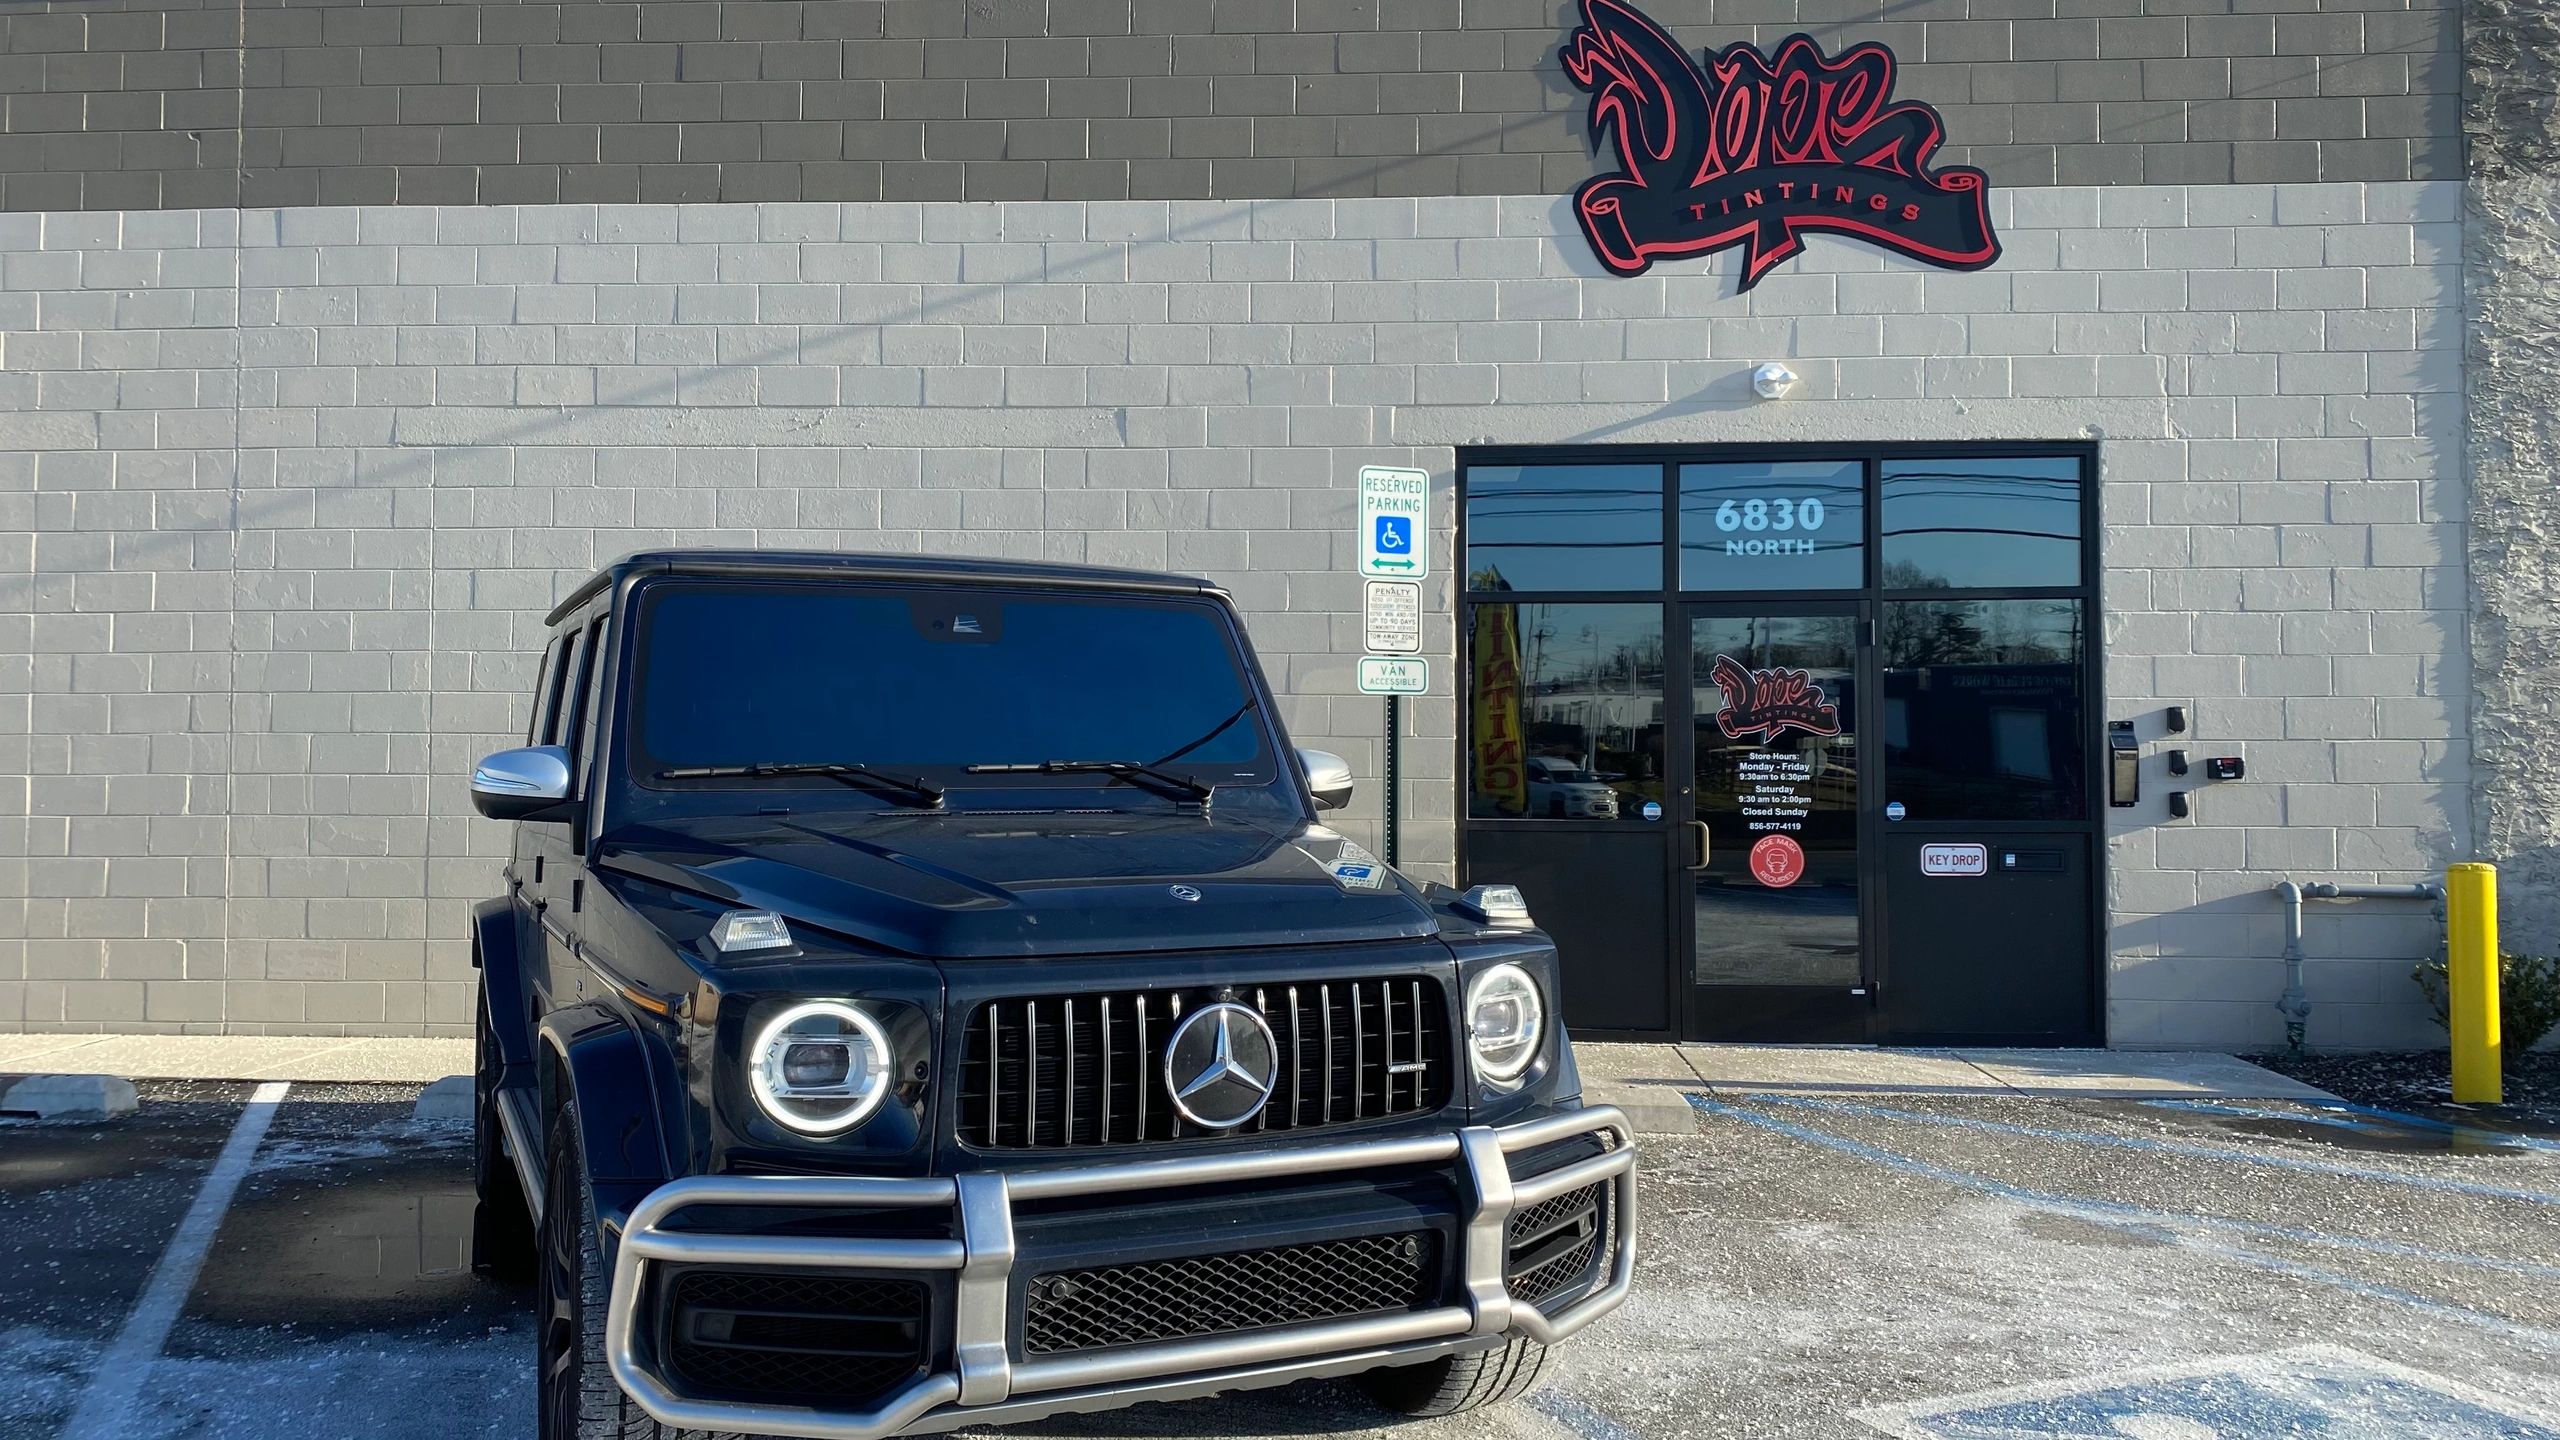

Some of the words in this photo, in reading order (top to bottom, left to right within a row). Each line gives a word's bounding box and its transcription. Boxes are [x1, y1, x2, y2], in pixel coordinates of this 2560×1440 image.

[1561, 0, 1938, 190] Dope
[1690, 182, 1921, 221] TINTINGS
[1365, 477, 1422, 494] RESERVED
[1368, 496, 1420, 512] PARKING
[1715, 498, 1825, 532] 6830
[1726, 538, 1815, 556] NORTH
[1375, 588, 1410, 596] PENALTY
[1380, 665, 1406, 677] VAN
[1369, 677, 1417, 686] ACCESSIBLE
[1750, 709, 1816, 722] TINTINGS
[1750, 752, 1771, 760] Store
[1772, 752, 1800, 760] Hours:
[1739, 762, 1775, 772] Monday
[1782, 762, 1810, 772] Friday
[1739, 772, 1769, 780] 9:30am
[1780, 773, 1810, 782] 6:30pm
[1755, 784, 1795, 795] Saturday
[1738, 795, 1756, 803] 9:30
[1781, 795, 1812, 804] 2:00pm
[1742, 807, 1773, 816] Closed
[1774, 807, 1808, 818] Sunday
[1749, 822, 1802, 830] 856-577-4119
[1756, 838, 1774, 854] FACE
[1776, 837, 1798, 854] MASK
[1928, 854, 1949, 866] KEY
[1952, 854, 1981, 866] DROP
[1760, 870, 1795, 883] REQUIRED
